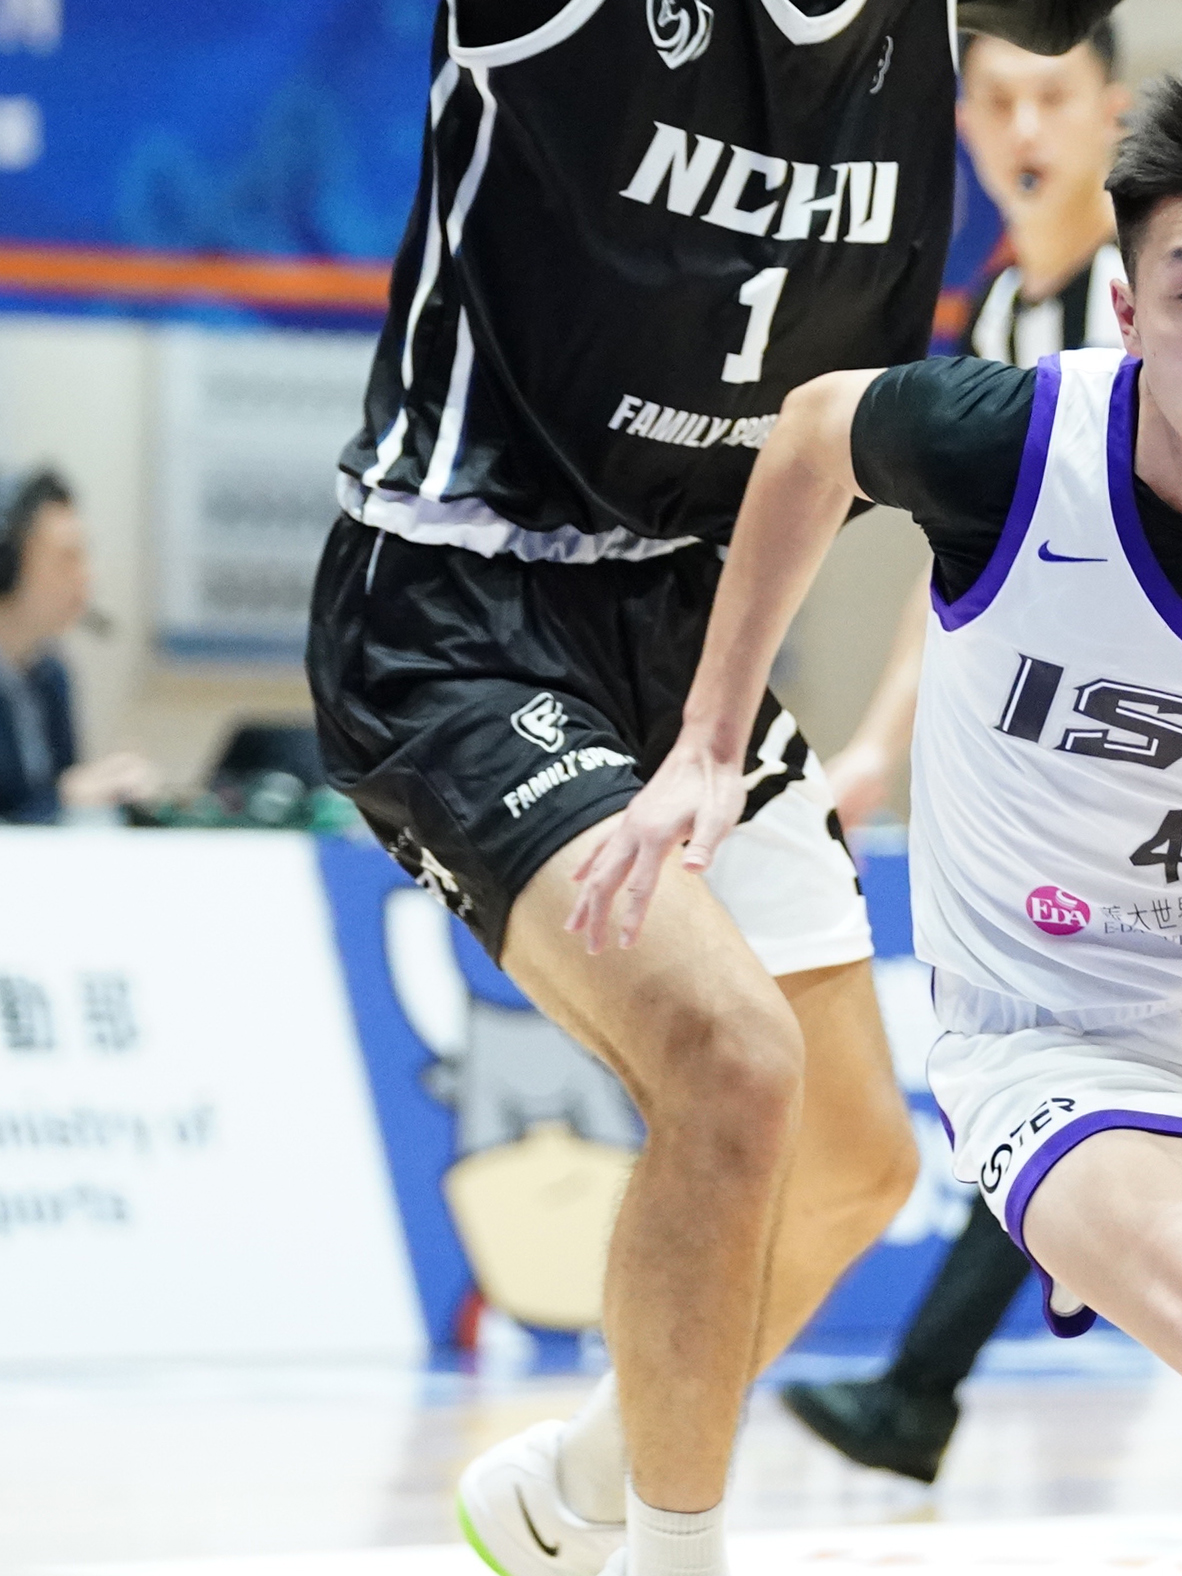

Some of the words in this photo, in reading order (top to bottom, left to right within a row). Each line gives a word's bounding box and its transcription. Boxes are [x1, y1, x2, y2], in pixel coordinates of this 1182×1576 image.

[618, 120, 899, 244] NCHU
[721, 267, 789, 384] 1
[607, 393, 733, 449] FAMILY
[502, 750, 579, 819] FAMILY
[1030, 896, 1088, 928] EDA
